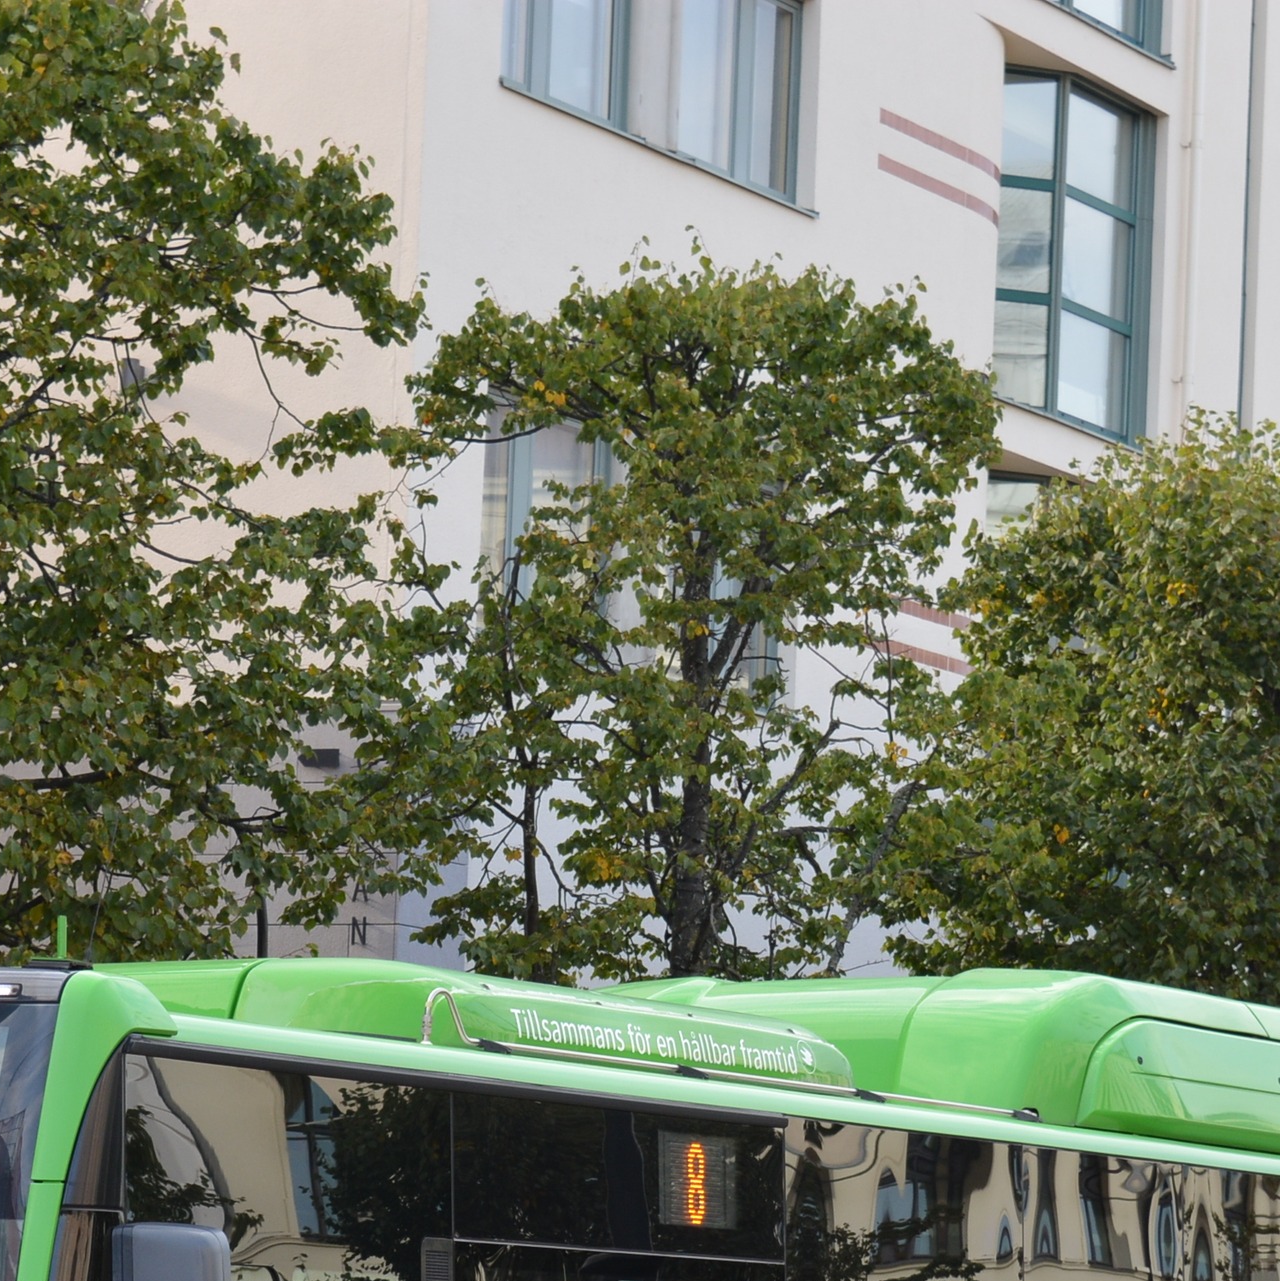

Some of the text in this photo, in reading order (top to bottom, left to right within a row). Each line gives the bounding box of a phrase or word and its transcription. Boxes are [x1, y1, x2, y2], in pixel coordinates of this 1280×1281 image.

[510, 1008, 799, 1075] Tillsammans för en hållbar framtid
[687, 1143, 705, 1225] 8
